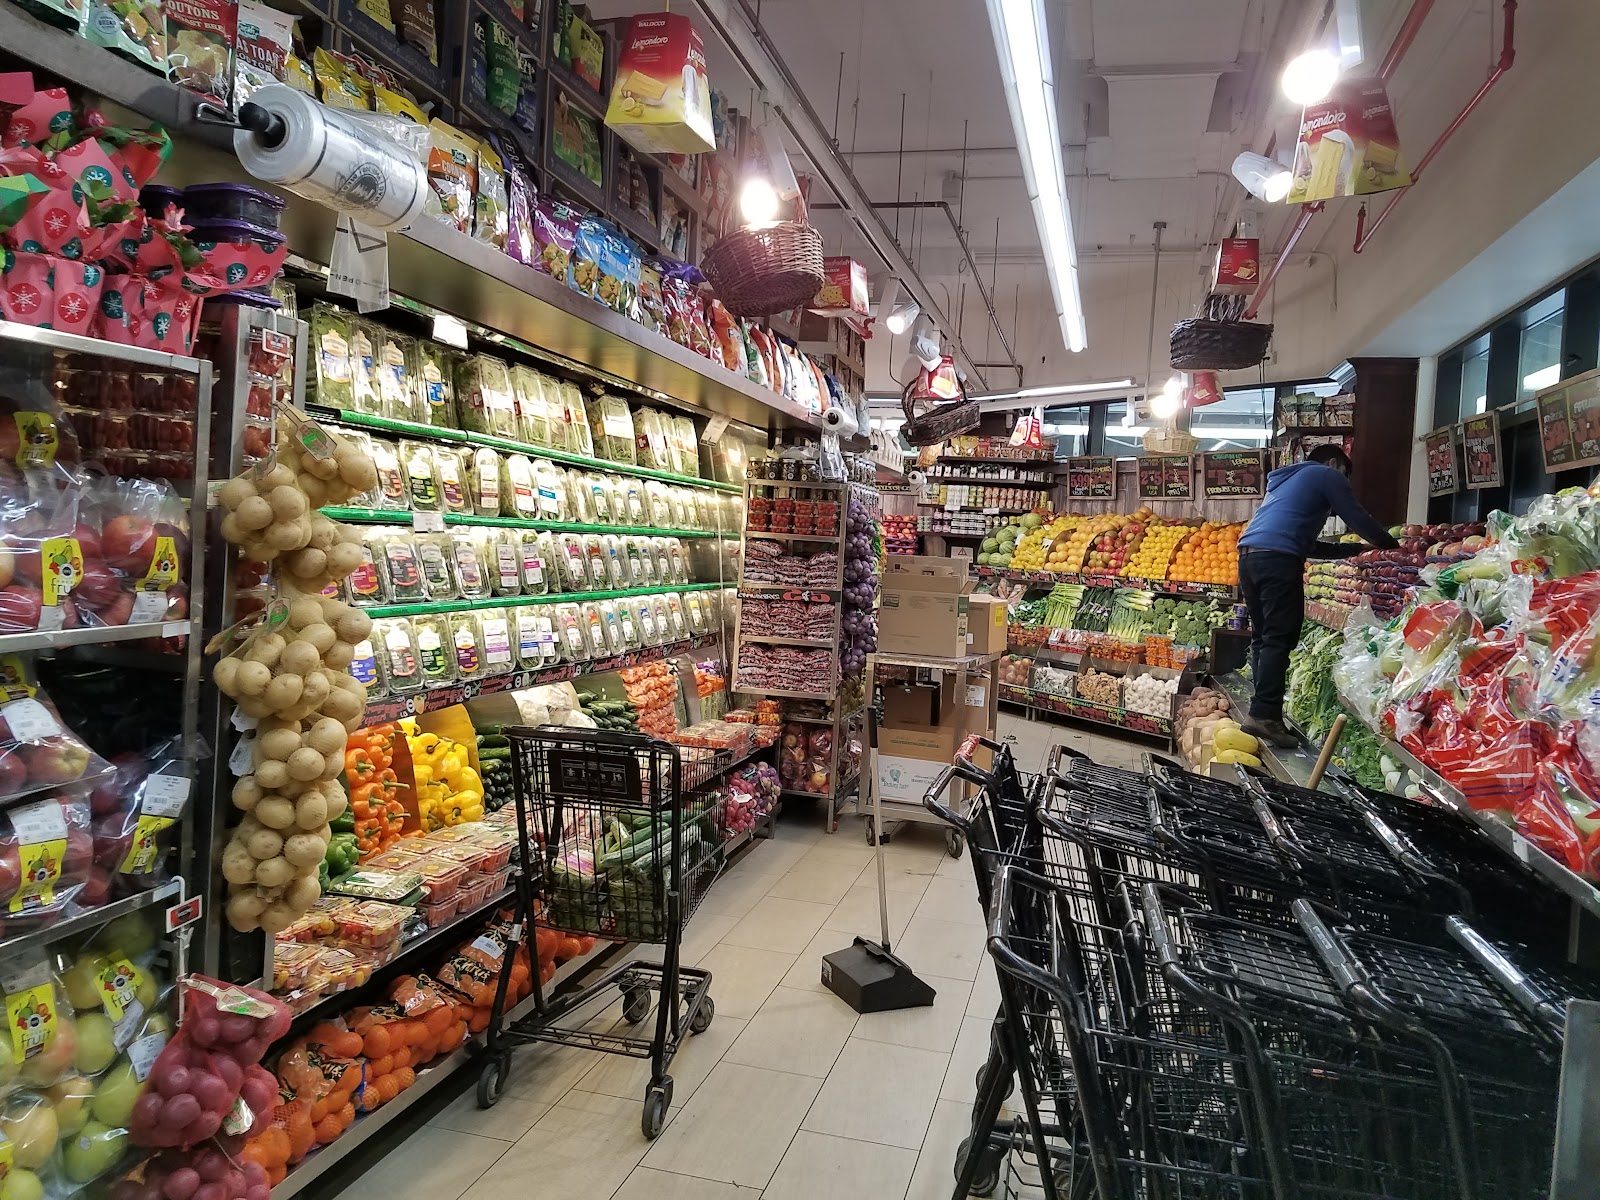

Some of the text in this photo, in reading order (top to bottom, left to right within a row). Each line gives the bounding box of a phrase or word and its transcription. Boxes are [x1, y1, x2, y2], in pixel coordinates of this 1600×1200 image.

[637, 20, 666, 28] BALOCCO
[630, 35, 669, 50] Lemondoro
[335, 272, 362, 286] OPEN
[1231, 458, 1260, 466] LEMONS
[21, 1029, 52, 1048] fruit
